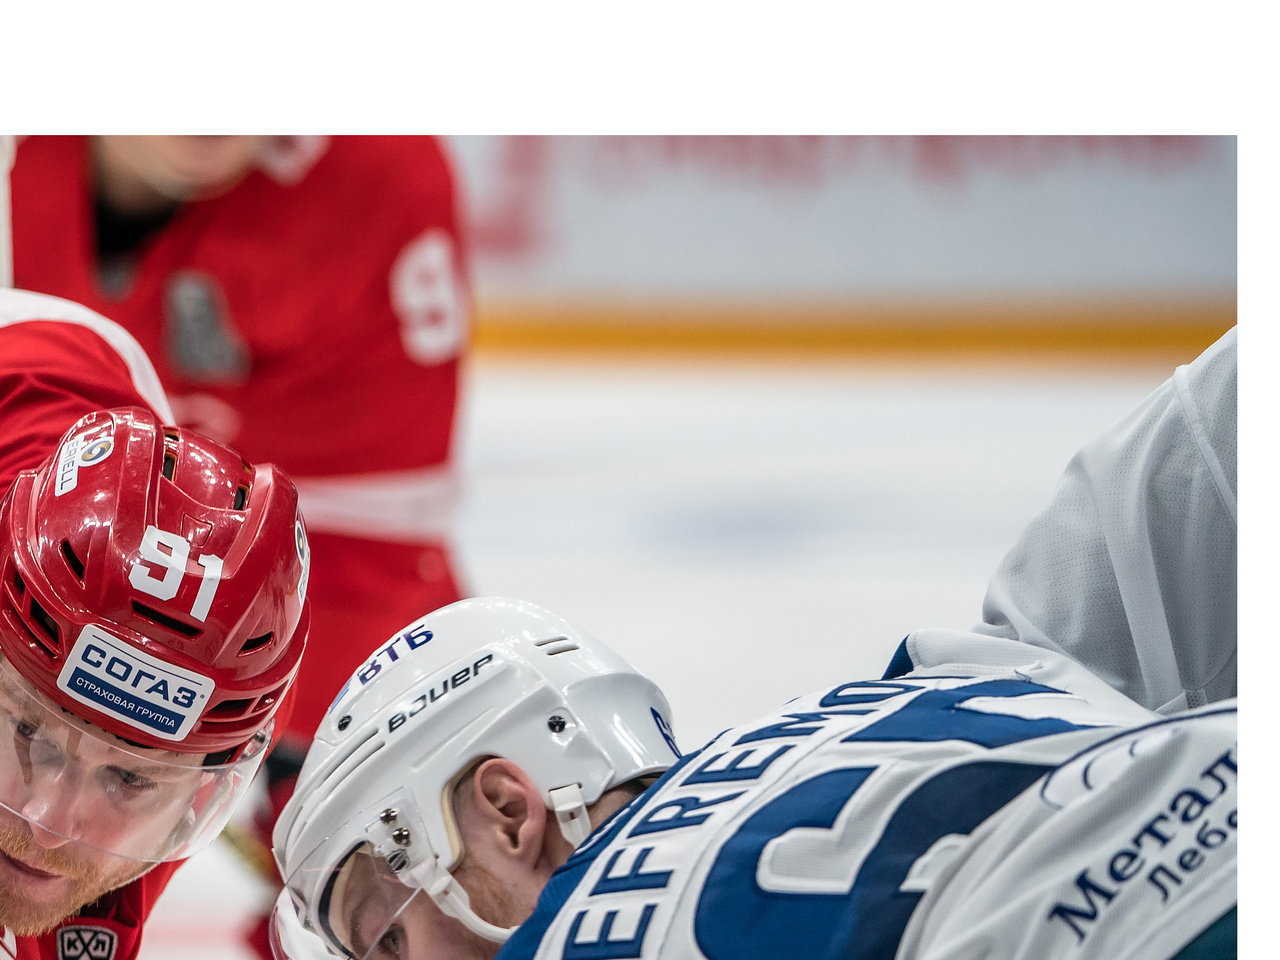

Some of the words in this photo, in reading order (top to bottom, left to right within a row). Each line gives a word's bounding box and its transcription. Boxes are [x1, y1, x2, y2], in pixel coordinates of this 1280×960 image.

[128, 525, 224, 623] 91
[75, 676, 136, 712] СТРАХОВАЯ
[134, 705, 176, 728] ГРУППА
[80, 643, 197, 709] СОГАЗ
